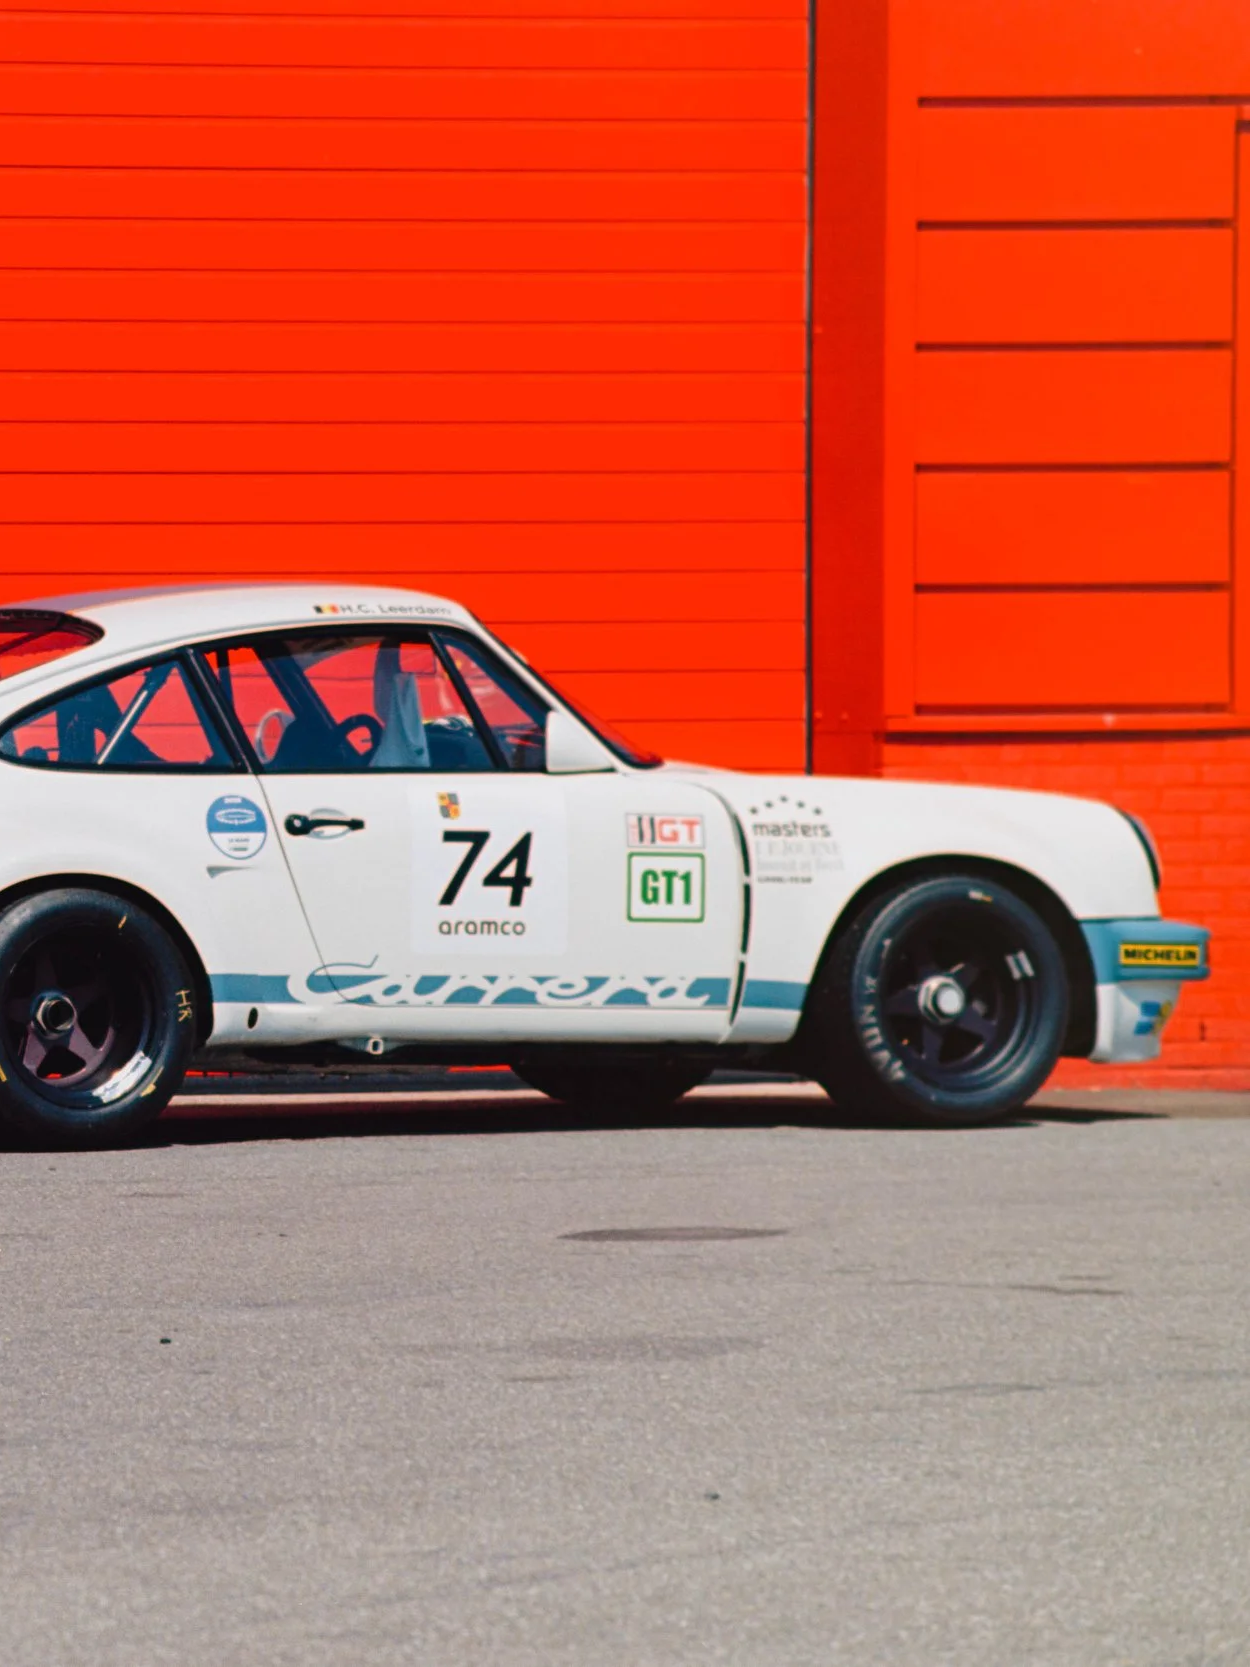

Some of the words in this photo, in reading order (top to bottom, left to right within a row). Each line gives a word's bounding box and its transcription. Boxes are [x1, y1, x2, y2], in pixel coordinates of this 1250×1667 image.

[341, 604, 375, 614] H.C.
[378, 605, 451, 615] Leerdam
[753, 820, 831, 838] masters
[438, 830, 533, 907] 74
[640, 869, 692, 905] GT1
[438, 920, 526, 936] aramco
[1124, 948, 1196, 961] MICHELIN
[287, 955, 711, 1005] Carrera
